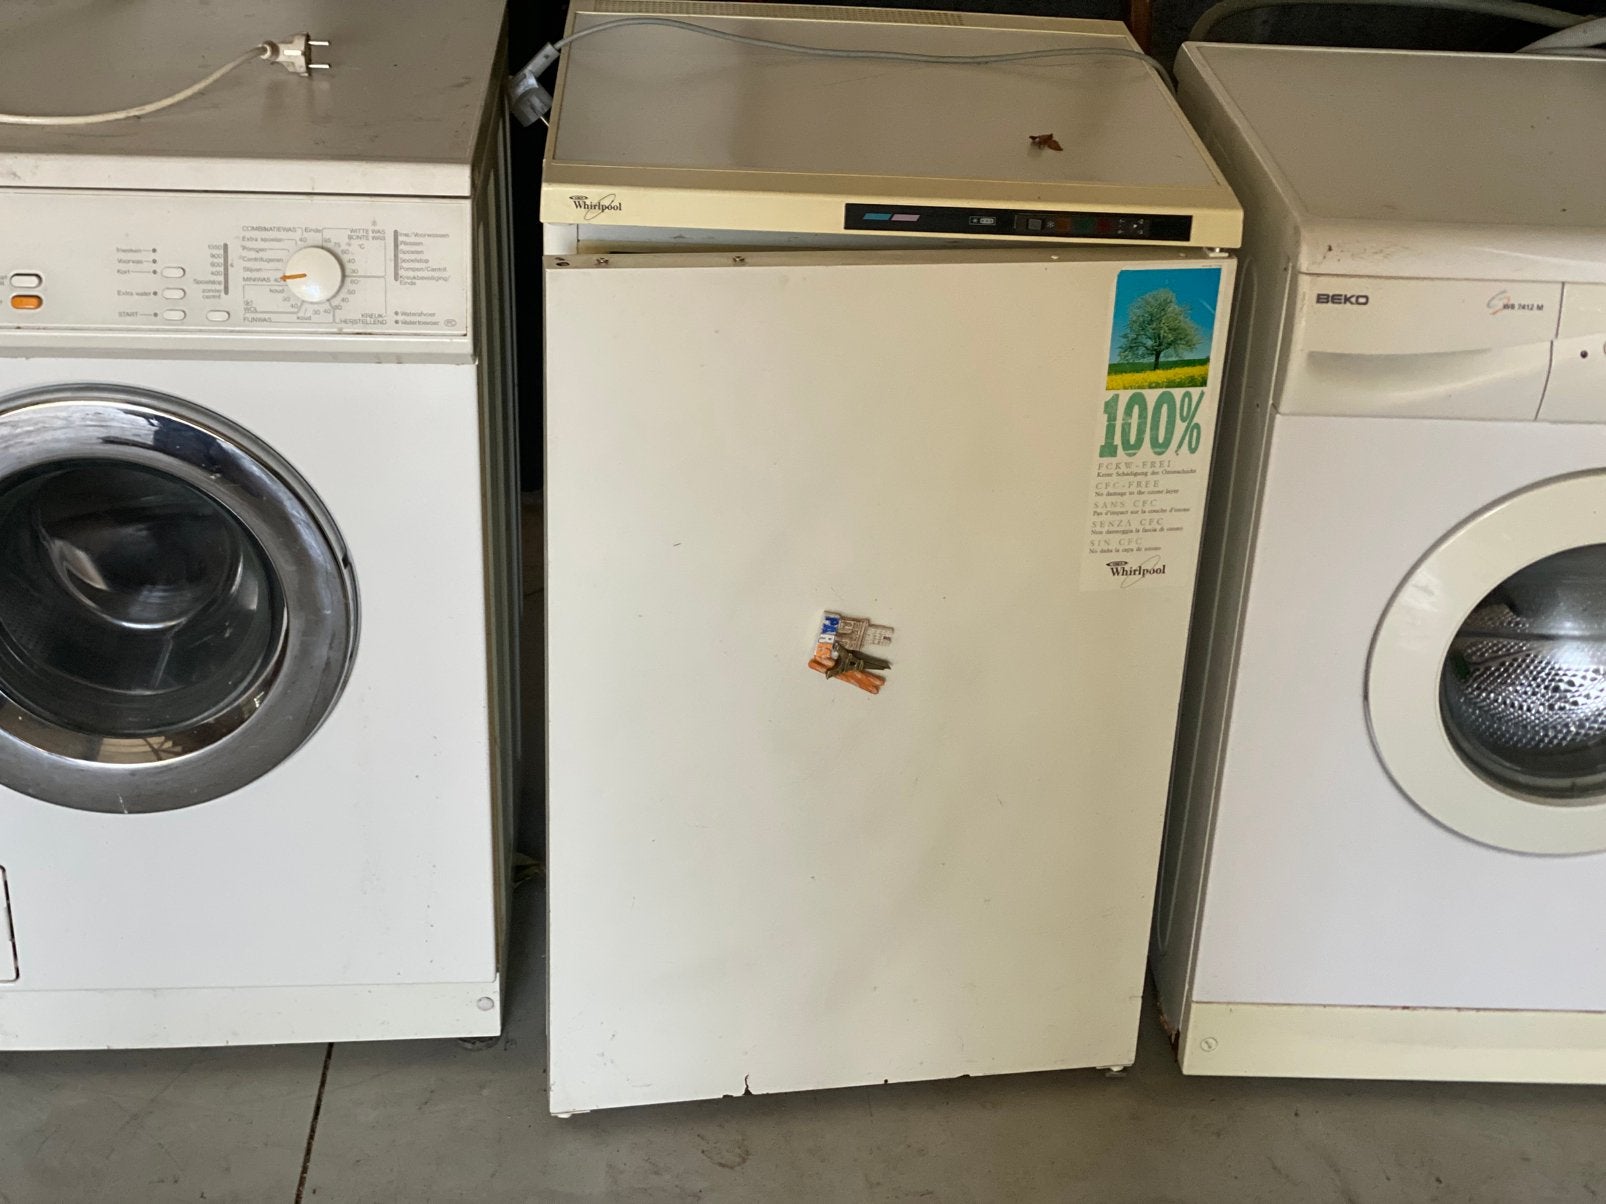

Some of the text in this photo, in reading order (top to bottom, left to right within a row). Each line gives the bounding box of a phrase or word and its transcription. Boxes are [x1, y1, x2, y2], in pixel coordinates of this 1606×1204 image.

[573, 200, 622, 213] Whirlpool
[1316, 293, 1369, 305] BEKO
[1099, 389, 1206, 458] 100%
[1097, 460, 1171, 470] FCKW-FREI
[1095, 480, 1160, 489] CFC-FREE
[1093, 499, 1157, 509] SANS CFC
[1090, 518, 1164, 528] SENZA CFC
[1118, 537, 1142, 546] CFC
[1111, 564, 1166, 578] Whirlpool
